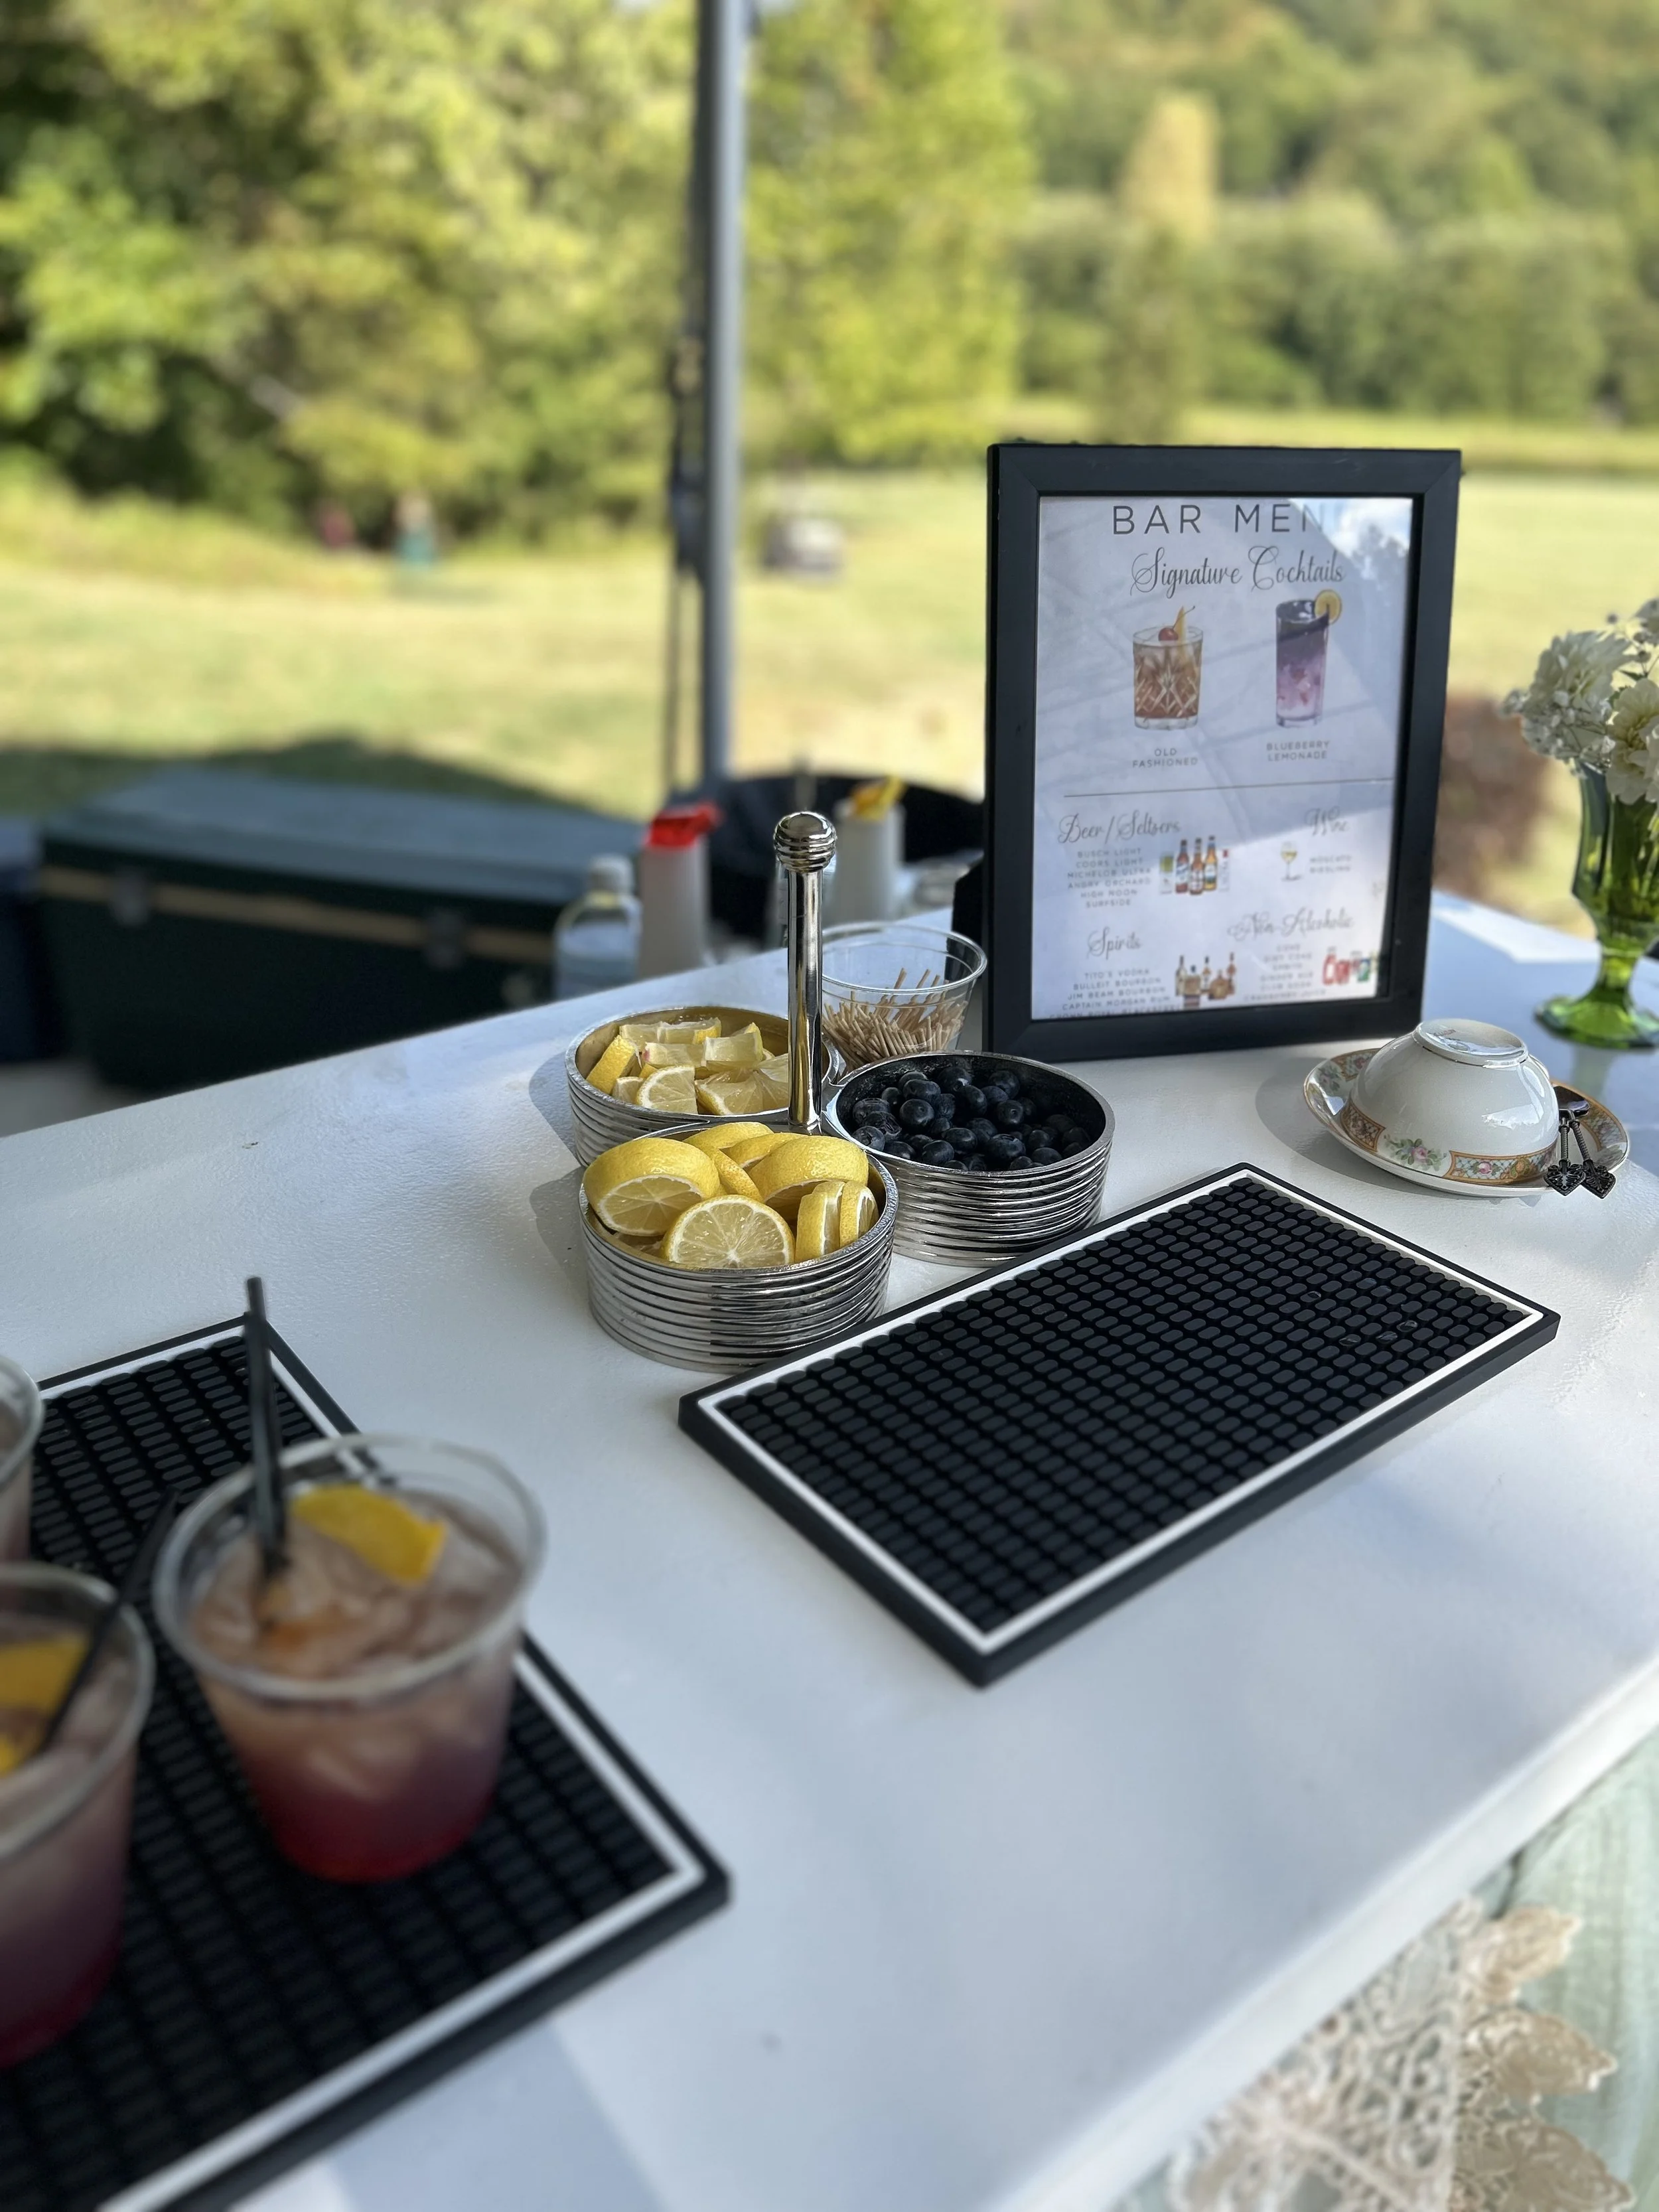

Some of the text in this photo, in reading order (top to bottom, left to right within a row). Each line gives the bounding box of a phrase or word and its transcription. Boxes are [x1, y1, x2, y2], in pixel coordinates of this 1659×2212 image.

[1113, 504, 1201, 534] BAR
[1130, 546, 1346, 599] Signature Cocktails
[1266, 740, 1331, 751] BLUEBERRY
[1154, 748, 1177, 757] OLD
[1267, 751, 1328, 762] LEMONADE
[1132, 757, 1198, 768] FASHIONED
[1078, 848, 1141, 858] BUSCH LIGHT
[1076, 857, 1143, 869] COORS LIGHT
[1067, 867, 1151, 879] MICHELOB ULTRA
[1068, 877, 1151, 890] ANGRY ORCHARD
[1109, 888, 1137, 897] NOON
[1086, 899, 1131, 909] SURFSIDE
[1086, 926, 1143, 960] Spirits
[1073, 977, 1161, 991] BULLEIT BOURBON
[1068, 992, 1083, 1001] JIM
[1088, 990, 1114, 999] BEAM
[1062, 1001, 1102, 1011] CAPTAIN
